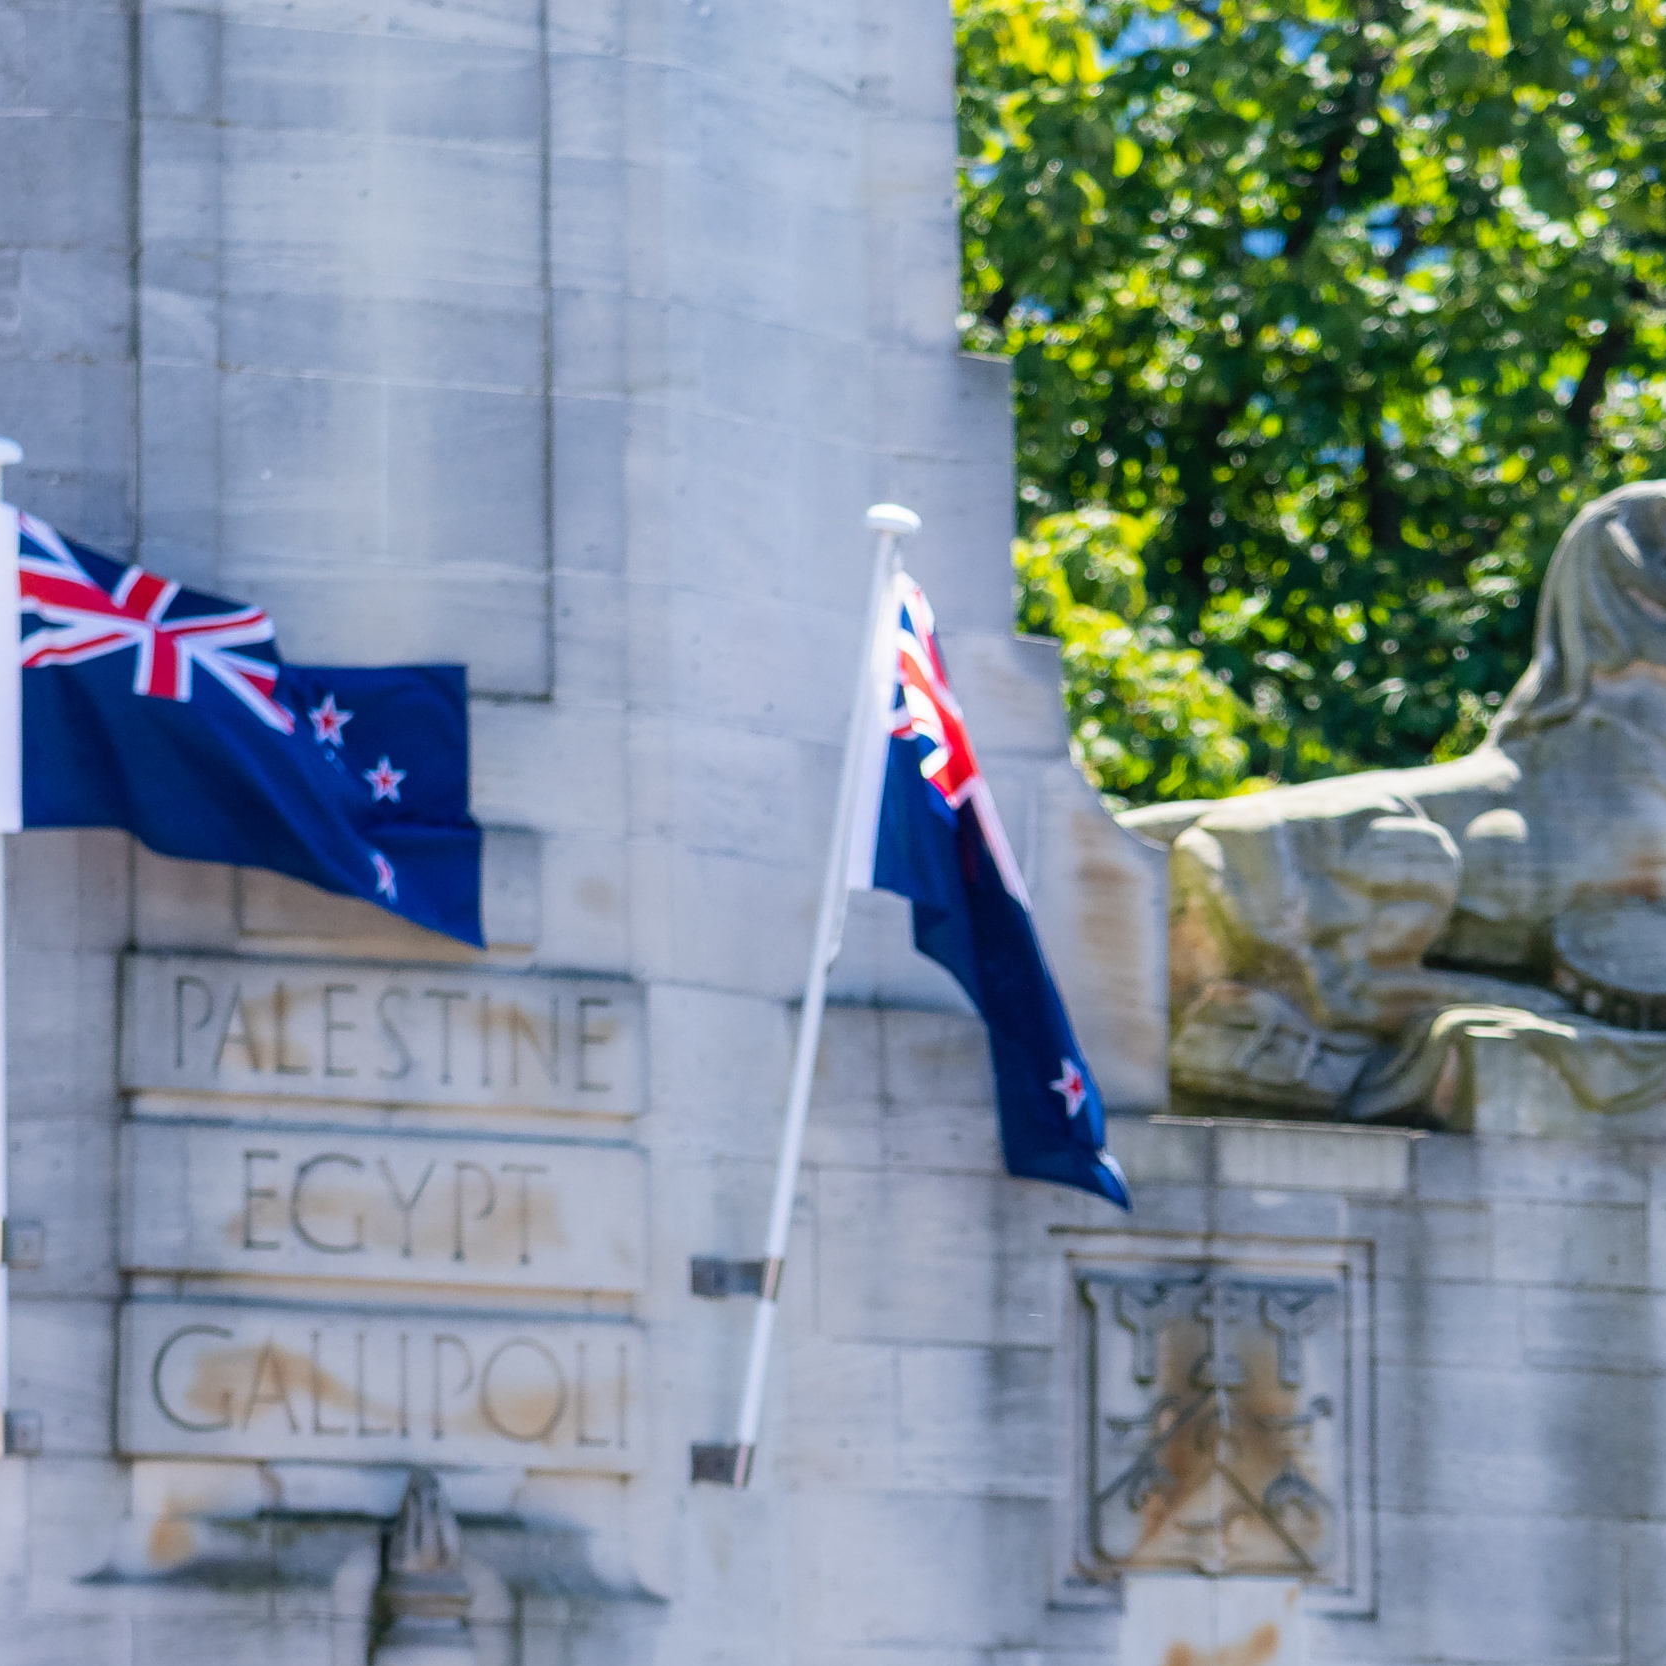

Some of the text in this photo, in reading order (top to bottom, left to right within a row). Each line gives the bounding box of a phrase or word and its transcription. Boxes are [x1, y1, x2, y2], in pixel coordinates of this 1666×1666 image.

[172, 975, 614, 1092] PALESTINE
[242, 1149, 550, 1266] EGYPT
[152, 1324, 631, 1449] GALLIPOLI
